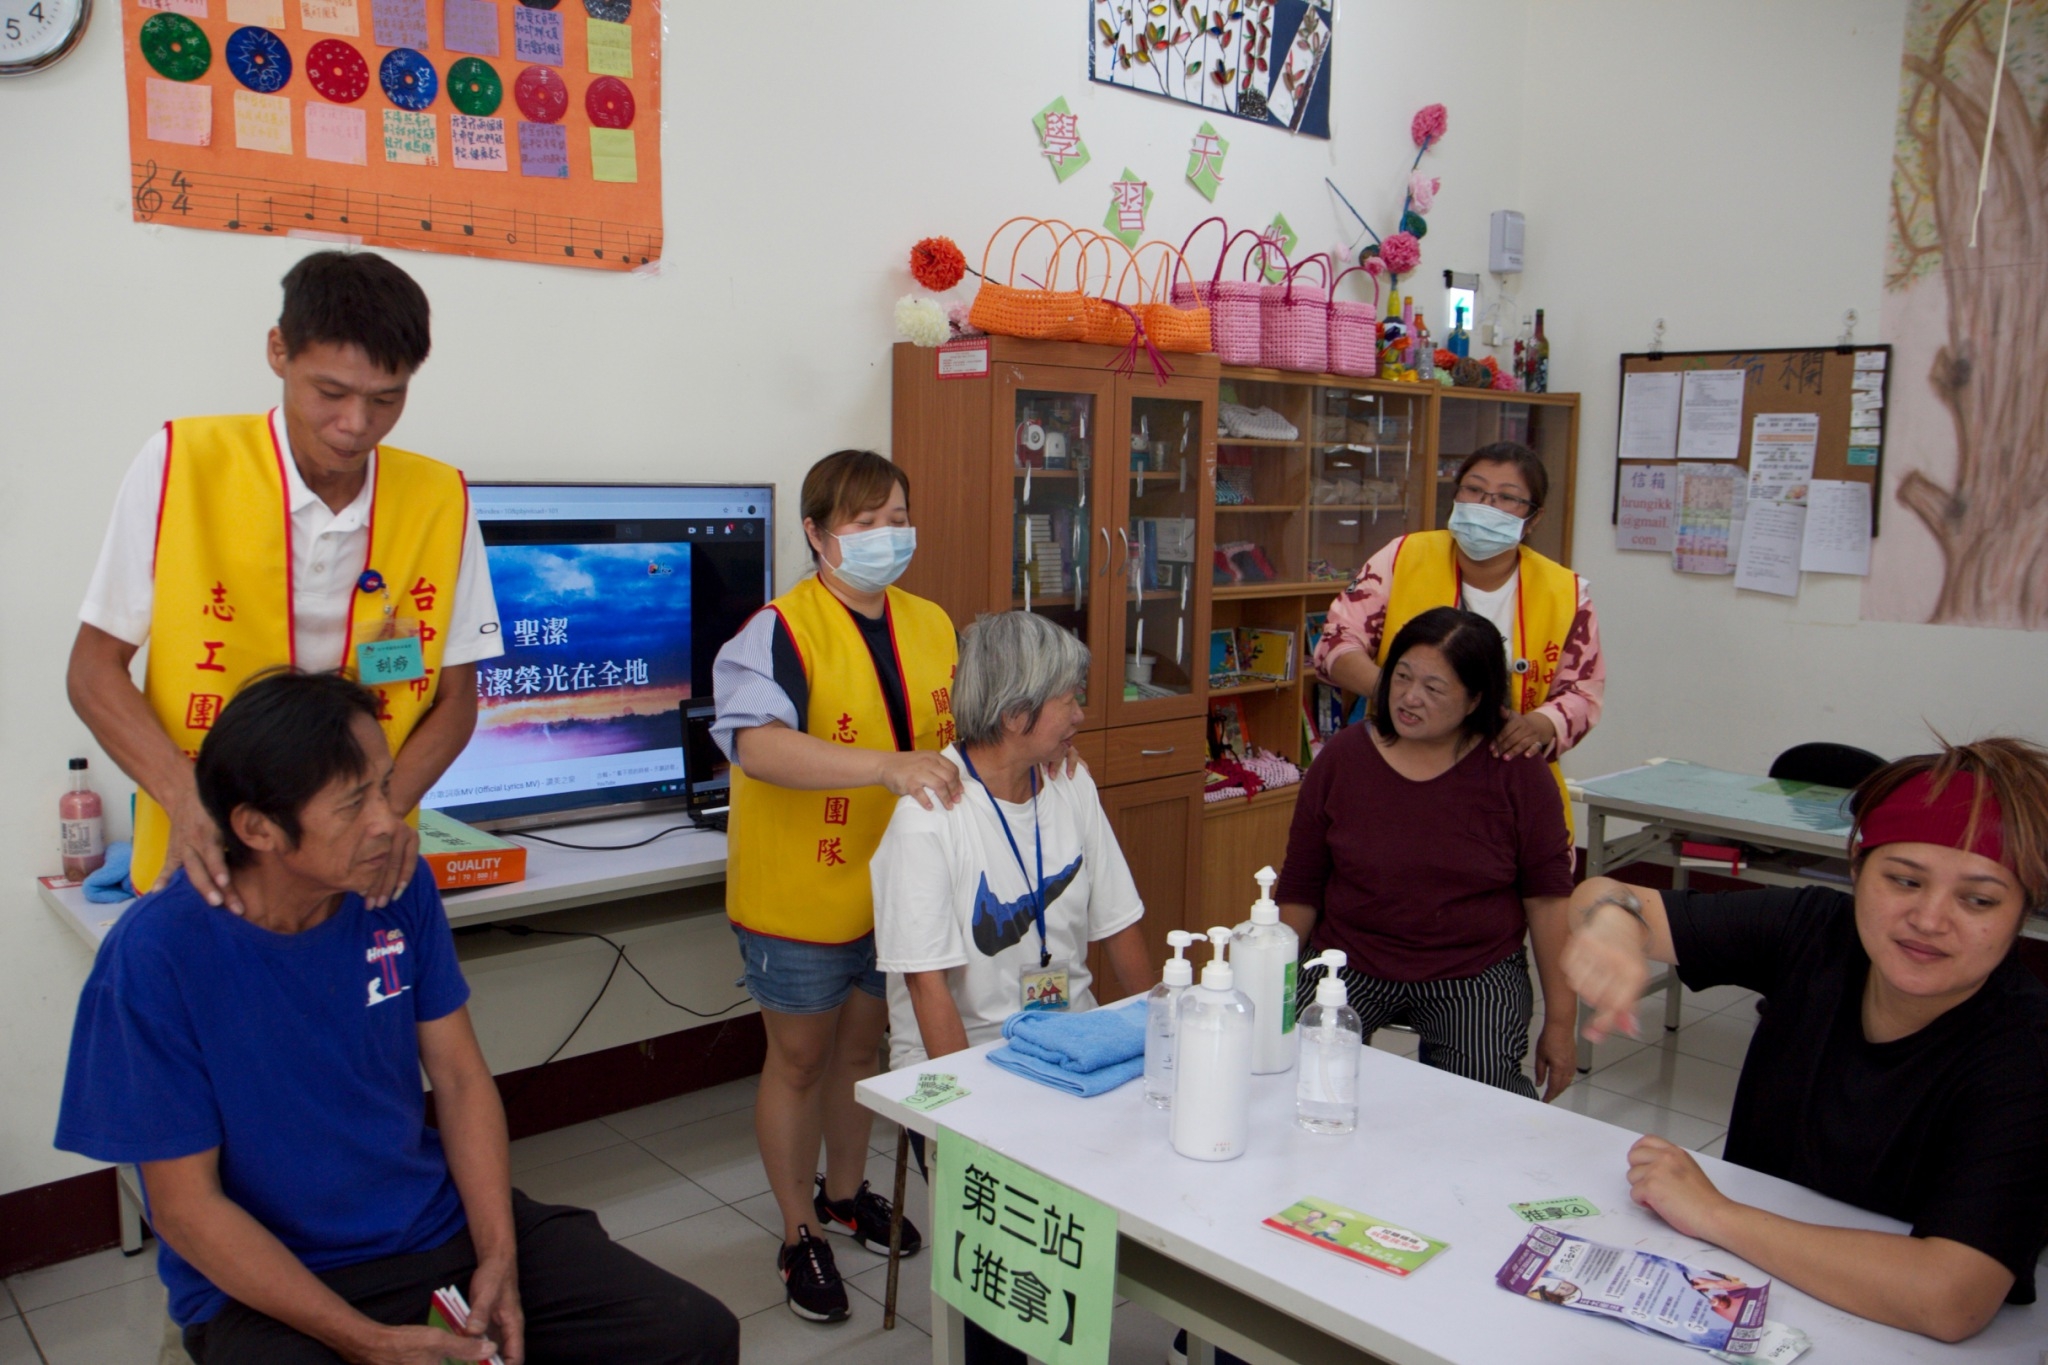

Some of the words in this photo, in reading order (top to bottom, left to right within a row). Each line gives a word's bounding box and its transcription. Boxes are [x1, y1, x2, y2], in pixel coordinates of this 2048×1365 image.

[29, 2, 44, 23] 4
[6, 18, 20, 40] 5
[1042, 112, 1080, 166] 學
[1112, 181, 1148, 232] 習
[1191, 133, 1224, 182] 天
[1632, 472, 1666, 489] 信箱
[1632, 535, 1657, 545] com
[513, 617, 569, 647] 聖潔
[185, 580, 235, 763] 志工團
[446, 857, 502, 873] QUALITY
[962, 1163, 1085, 1269] 第三站
